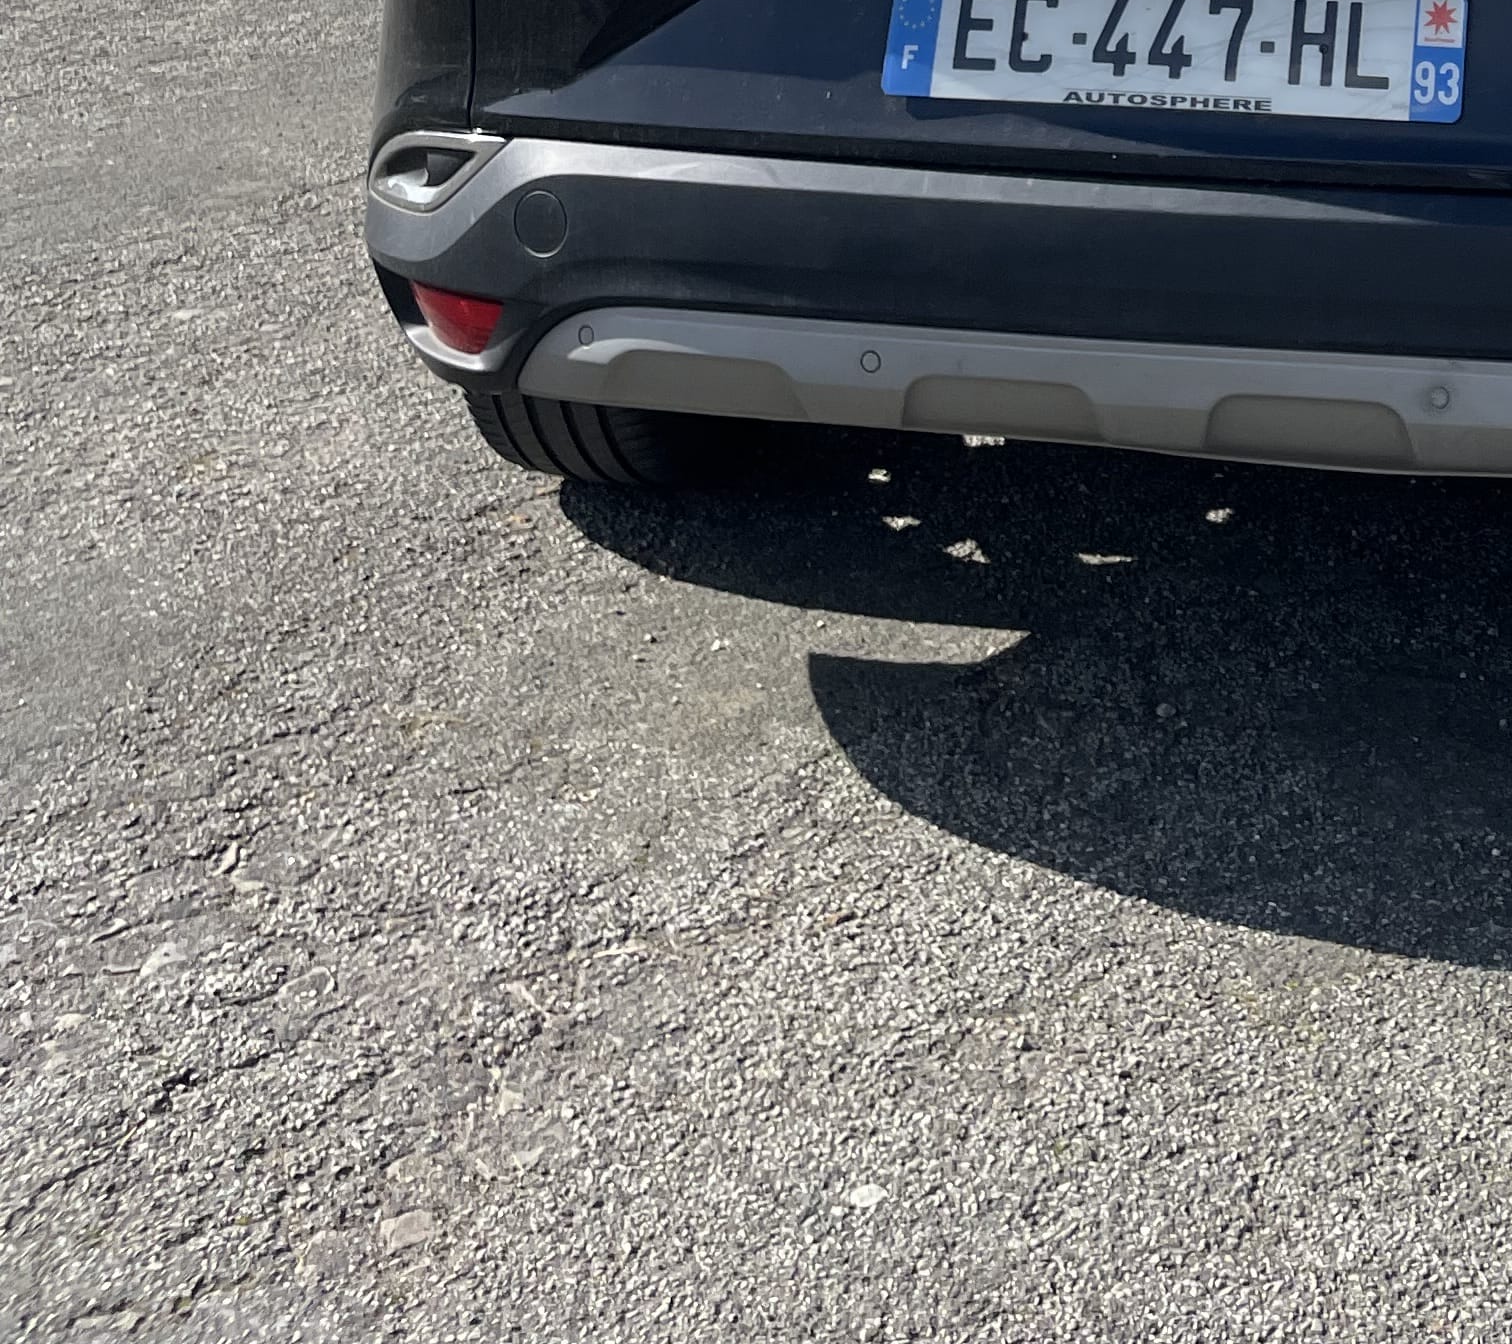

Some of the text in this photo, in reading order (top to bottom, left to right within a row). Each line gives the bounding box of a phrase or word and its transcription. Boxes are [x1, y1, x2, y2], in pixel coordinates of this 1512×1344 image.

[901, 44, 919, 69] F
[1414, 61, 1460, 105] 93
[1063, 90, 1272, 111] AUTOSPHERE
